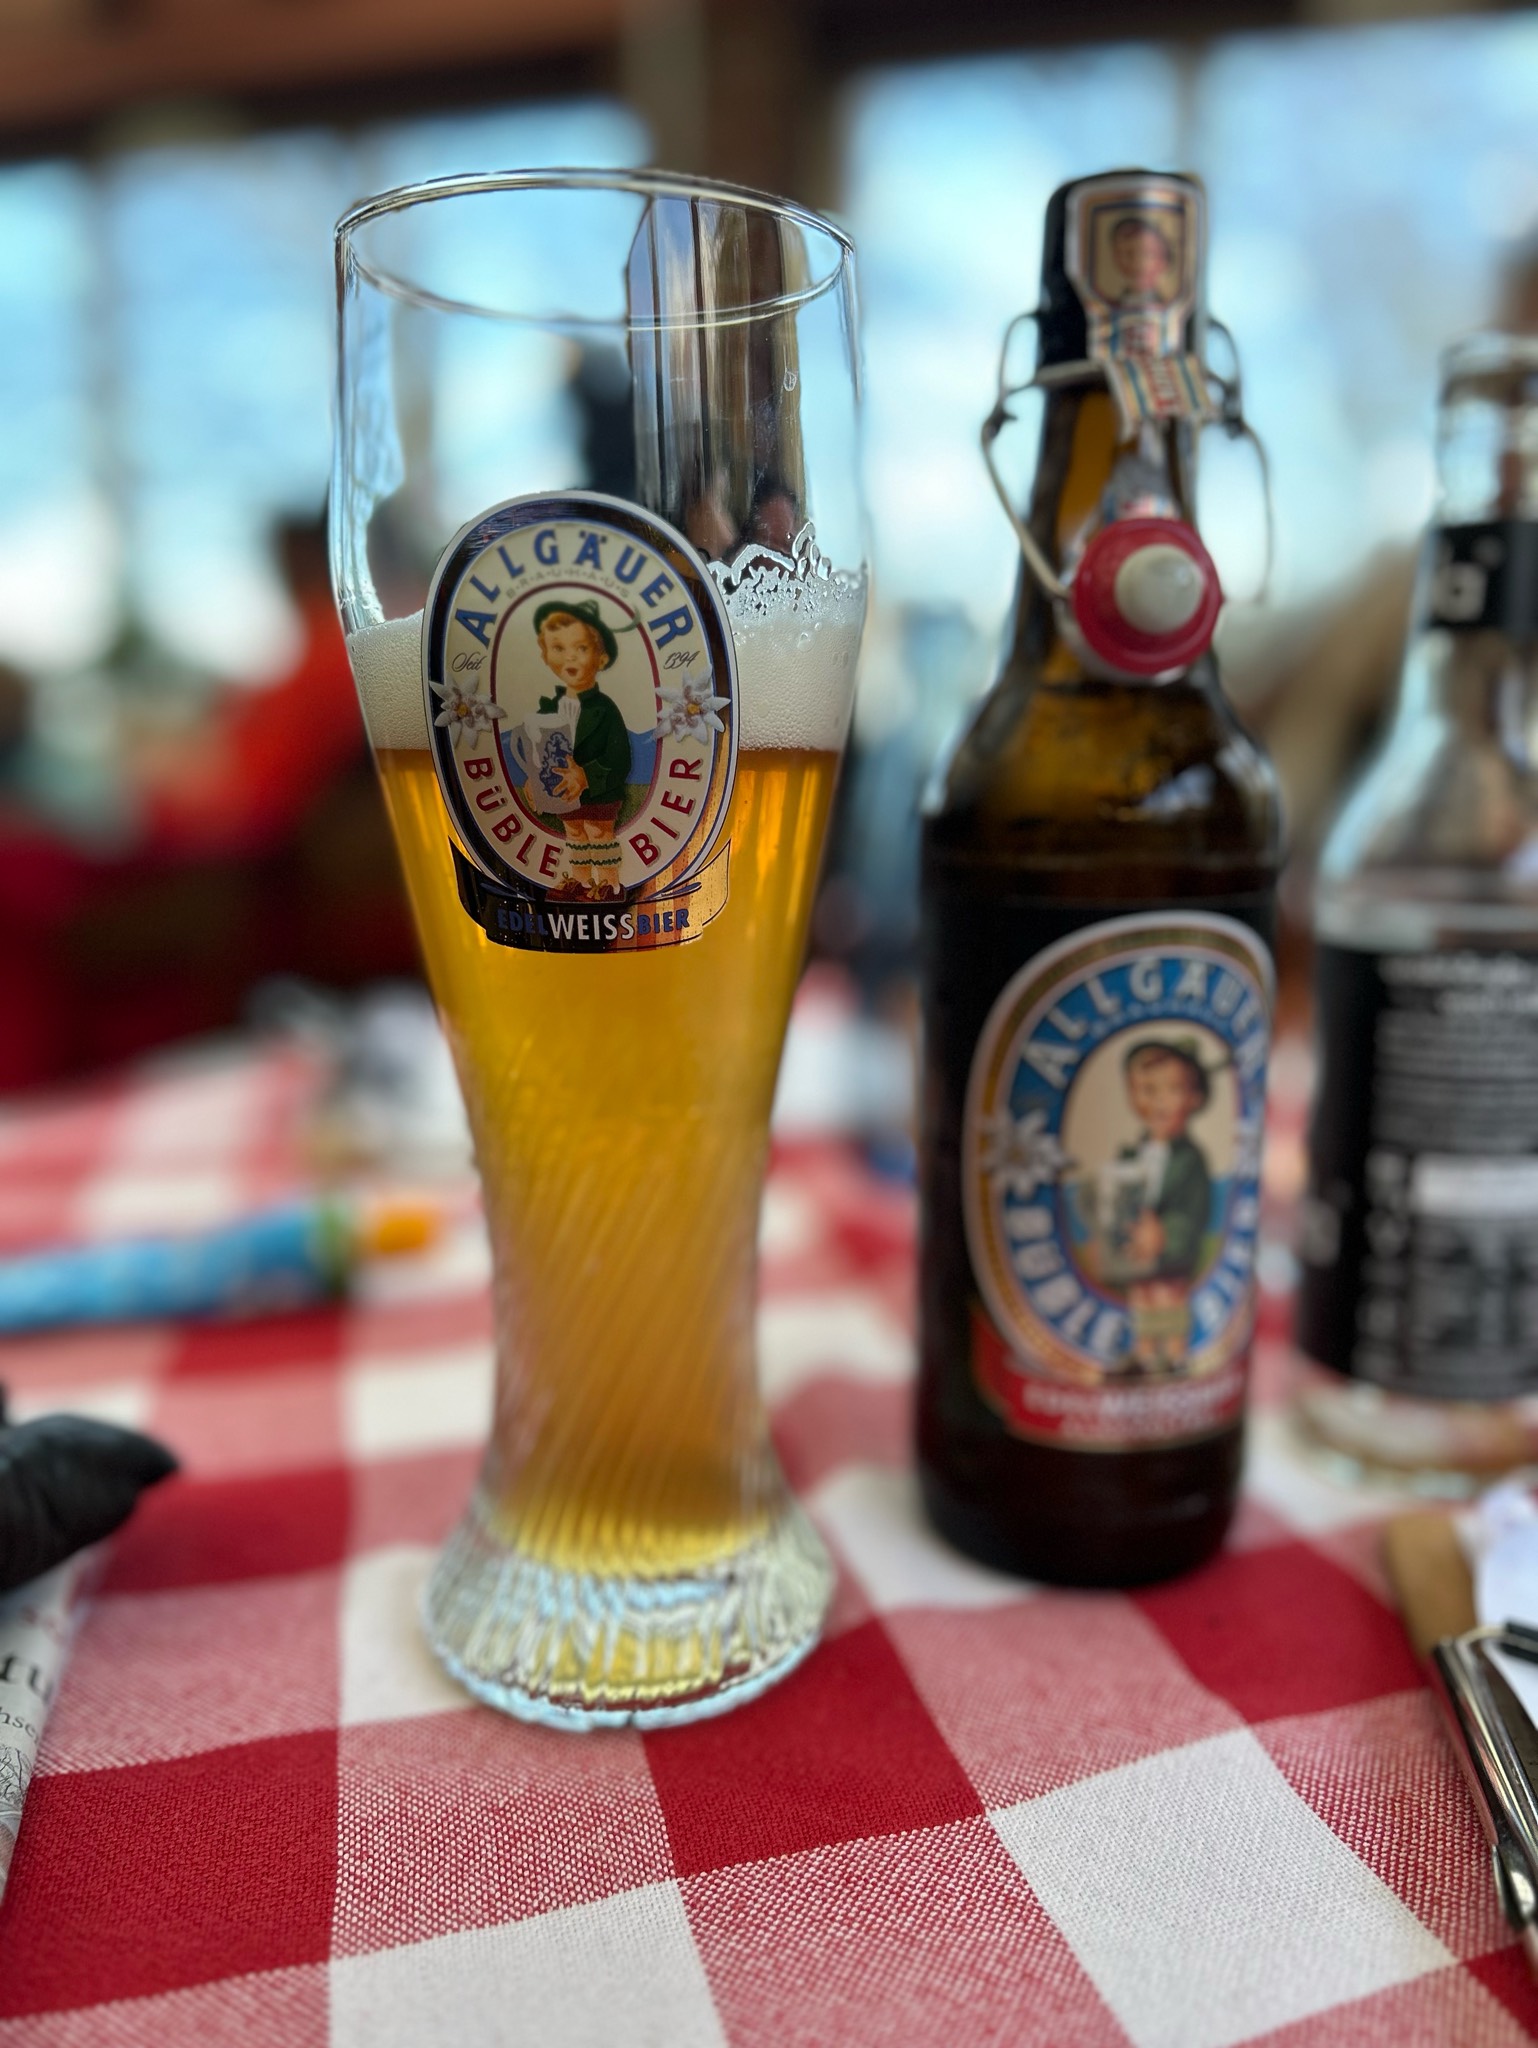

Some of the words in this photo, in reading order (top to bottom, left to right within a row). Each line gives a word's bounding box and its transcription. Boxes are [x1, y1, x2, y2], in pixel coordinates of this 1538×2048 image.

[455, 529, 694, 650] ALLGÄUER
[451, 651, 488, 672] Seit
[663, 650, 700, 669] 1394
[463, 757, 563, 877] BÜBLE
[629, 757, 703, 866] BIER
